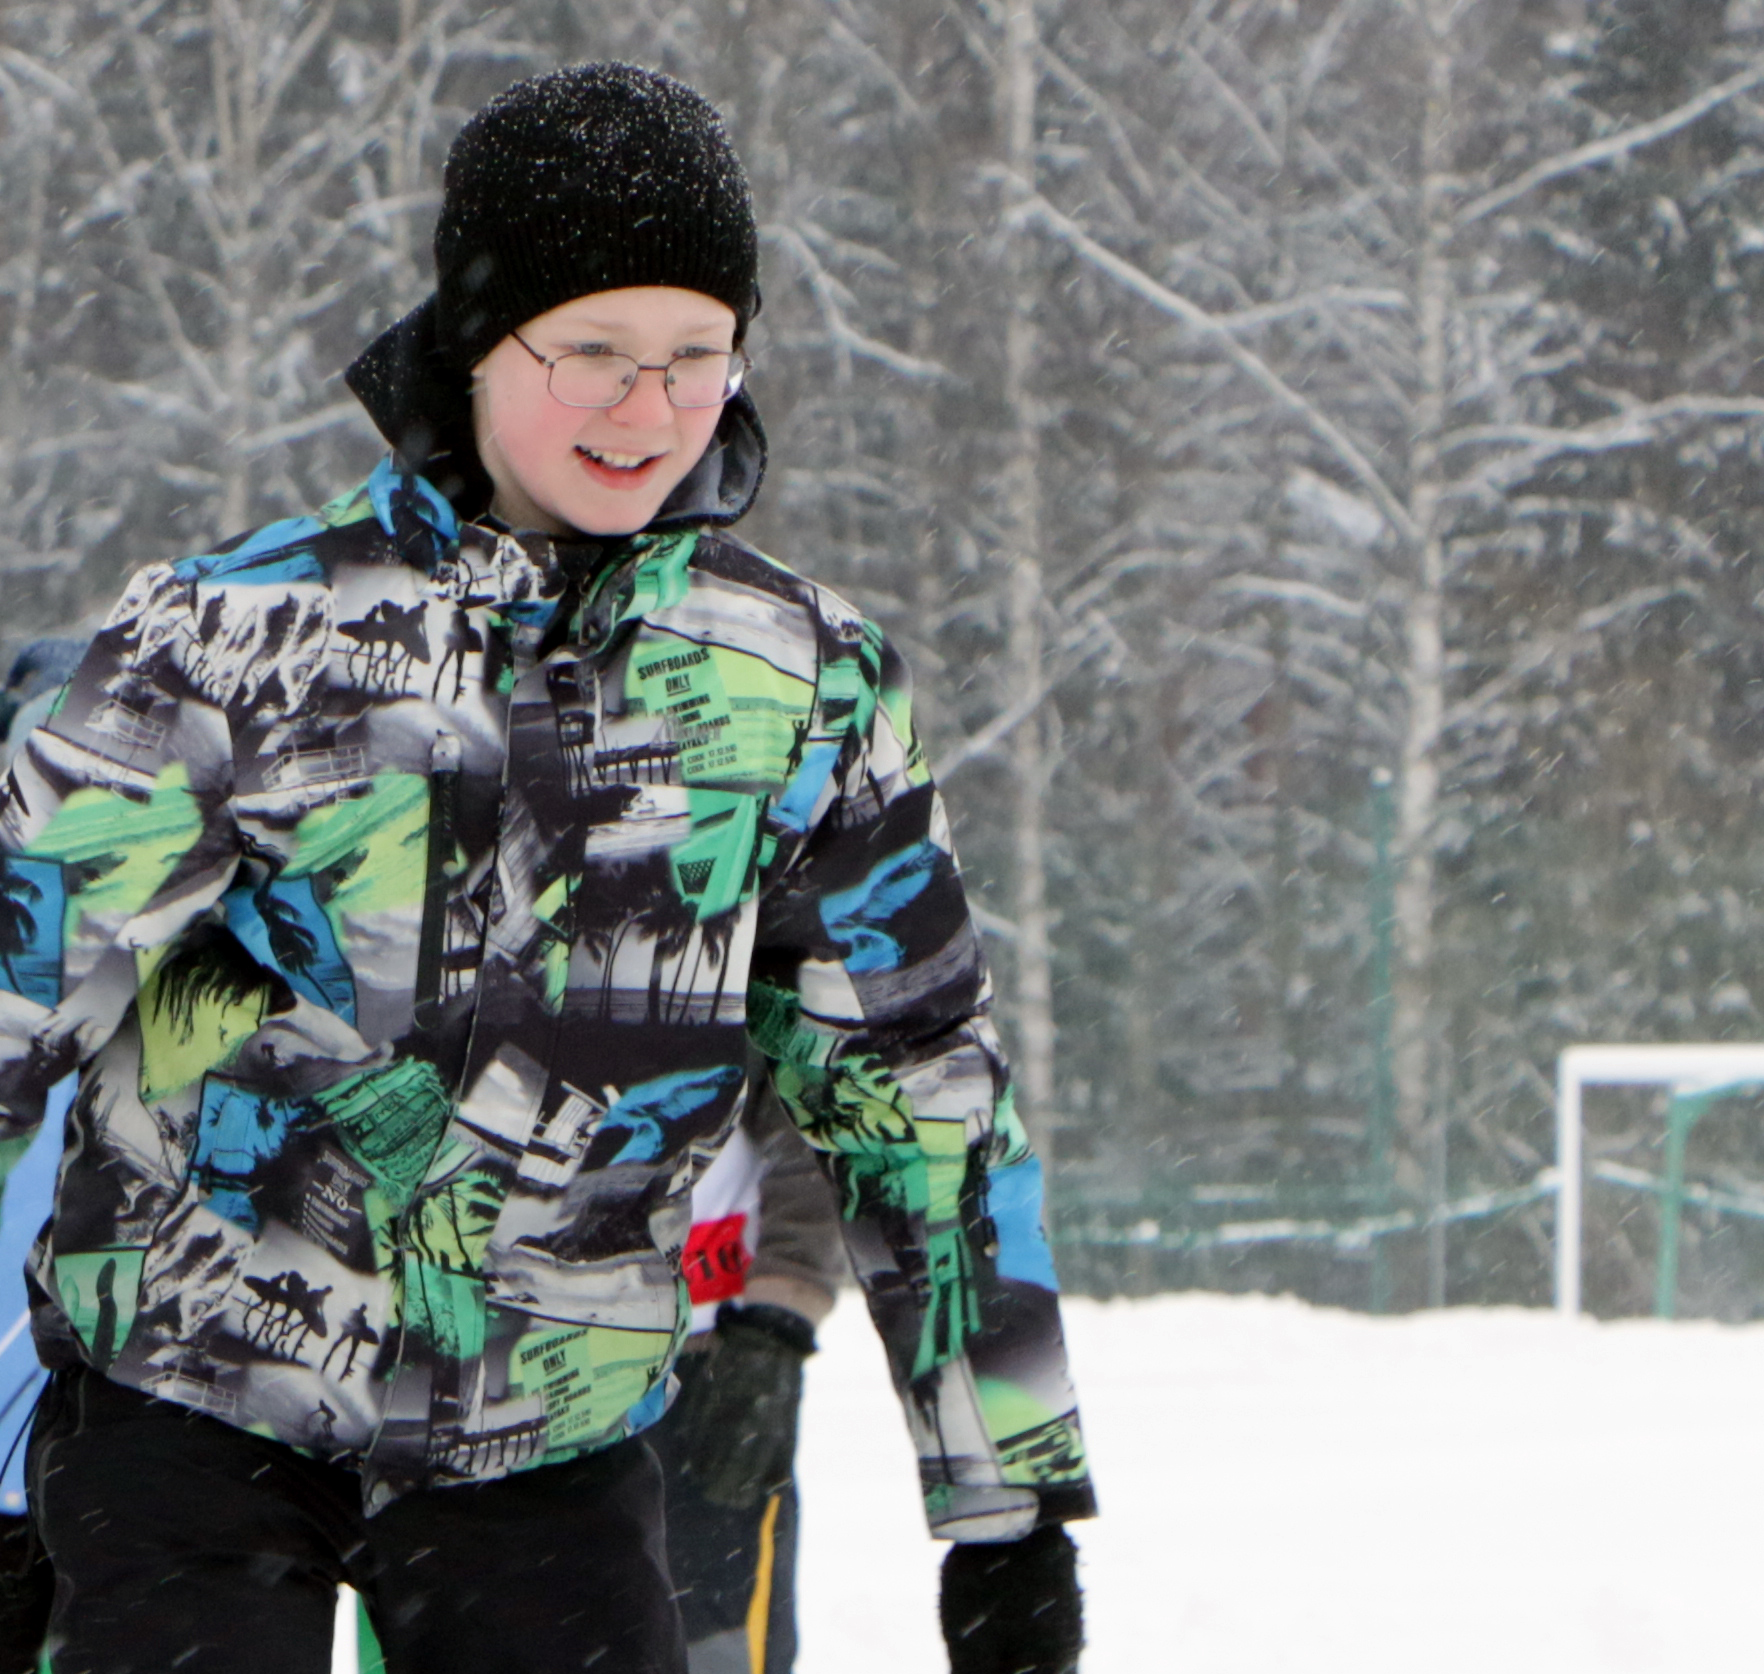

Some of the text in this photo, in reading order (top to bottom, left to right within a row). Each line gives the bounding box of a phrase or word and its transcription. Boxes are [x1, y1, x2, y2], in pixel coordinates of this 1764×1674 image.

[637, 647, 710, 680] SURFBOARDS
[665, 673, 690, 693] ONLY
[321, 1184, 349, 1211] NO
[542, 1348, 566, 1373] ONLY
